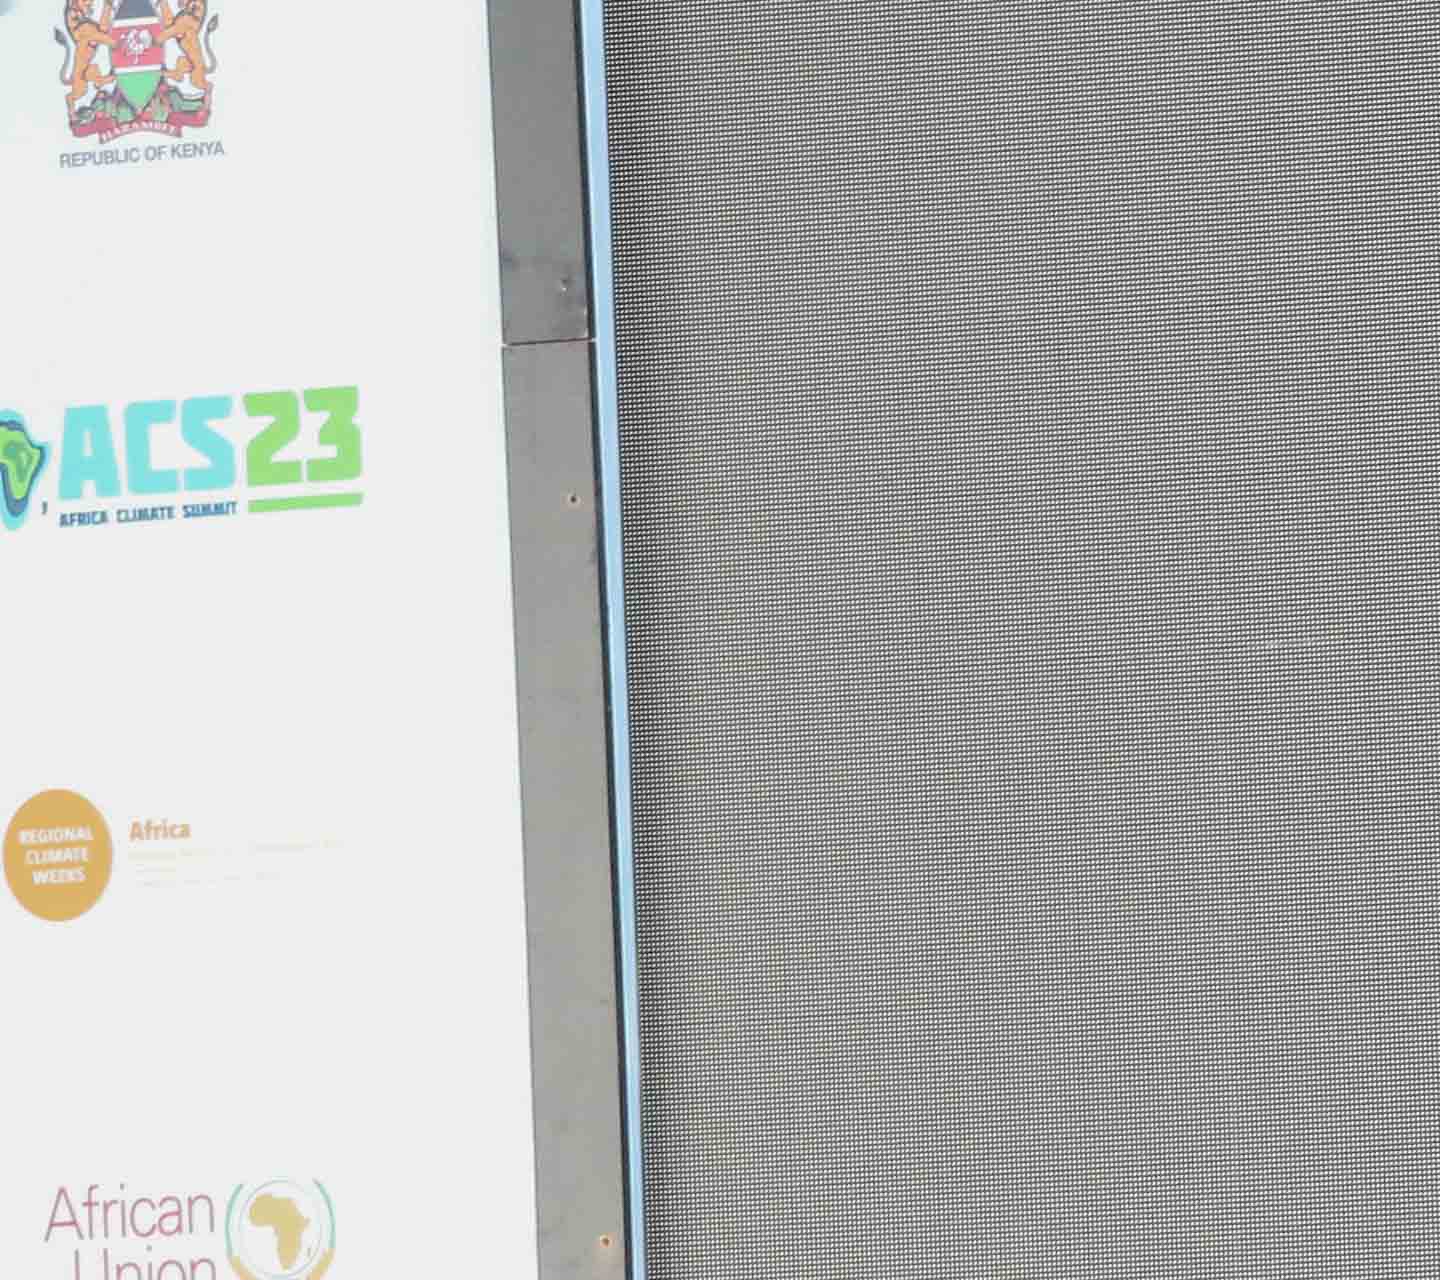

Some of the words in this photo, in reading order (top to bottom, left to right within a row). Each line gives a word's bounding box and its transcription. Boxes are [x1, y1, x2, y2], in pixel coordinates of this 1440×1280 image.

[59, 147, 141, 168] REPUBLIC
[144, 145, 167, 161] OF
[171, 141, 225, 160] KENYA
[58, 386, 363, 501] ACS23
[60, 509, 108, 528] AFRICA
[117, 505, 174, 524] CLIMATE
[183, 500, 237, 520] SUMMIT
[19, 827, 94, 845] REGIONAL
[129, 819, 192, 841] Africa
[25, 847, 89, 865] CLIMATE
[31, 868, 86, 885] WEEKS
[44, 1184, 216, 1242] African
